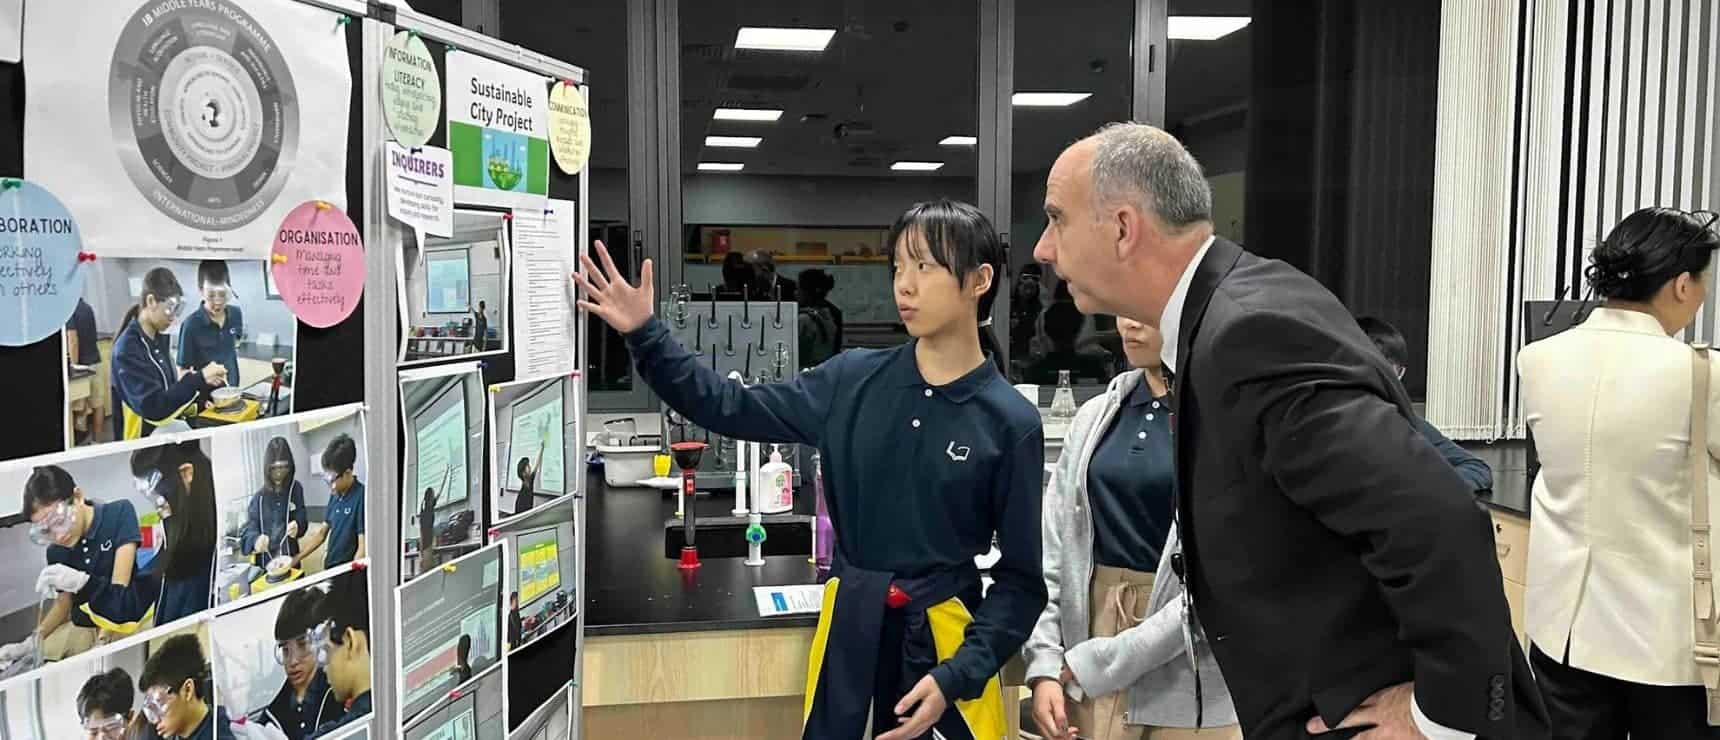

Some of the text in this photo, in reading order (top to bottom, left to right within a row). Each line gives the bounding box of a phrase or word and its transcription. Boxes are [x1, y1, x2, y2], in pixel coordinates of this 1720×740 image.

[142, 13, 153, 26] IB
[152, 0, 187, 17] MIDDLE
[189, 0, 216, 11] YEARS
[217, 3, 271, 54] PROGRAMME
[386, 46, 432, 73] INFORMATION
[393, 70, 425, 90] LITERACY
[470, 77, 533, 109] Sustainable
[470, 102, 533, 132] City Project
[391, 150, 445, 178] INQUIRERS
[279, 230, 359, 246] ORGANISATION
